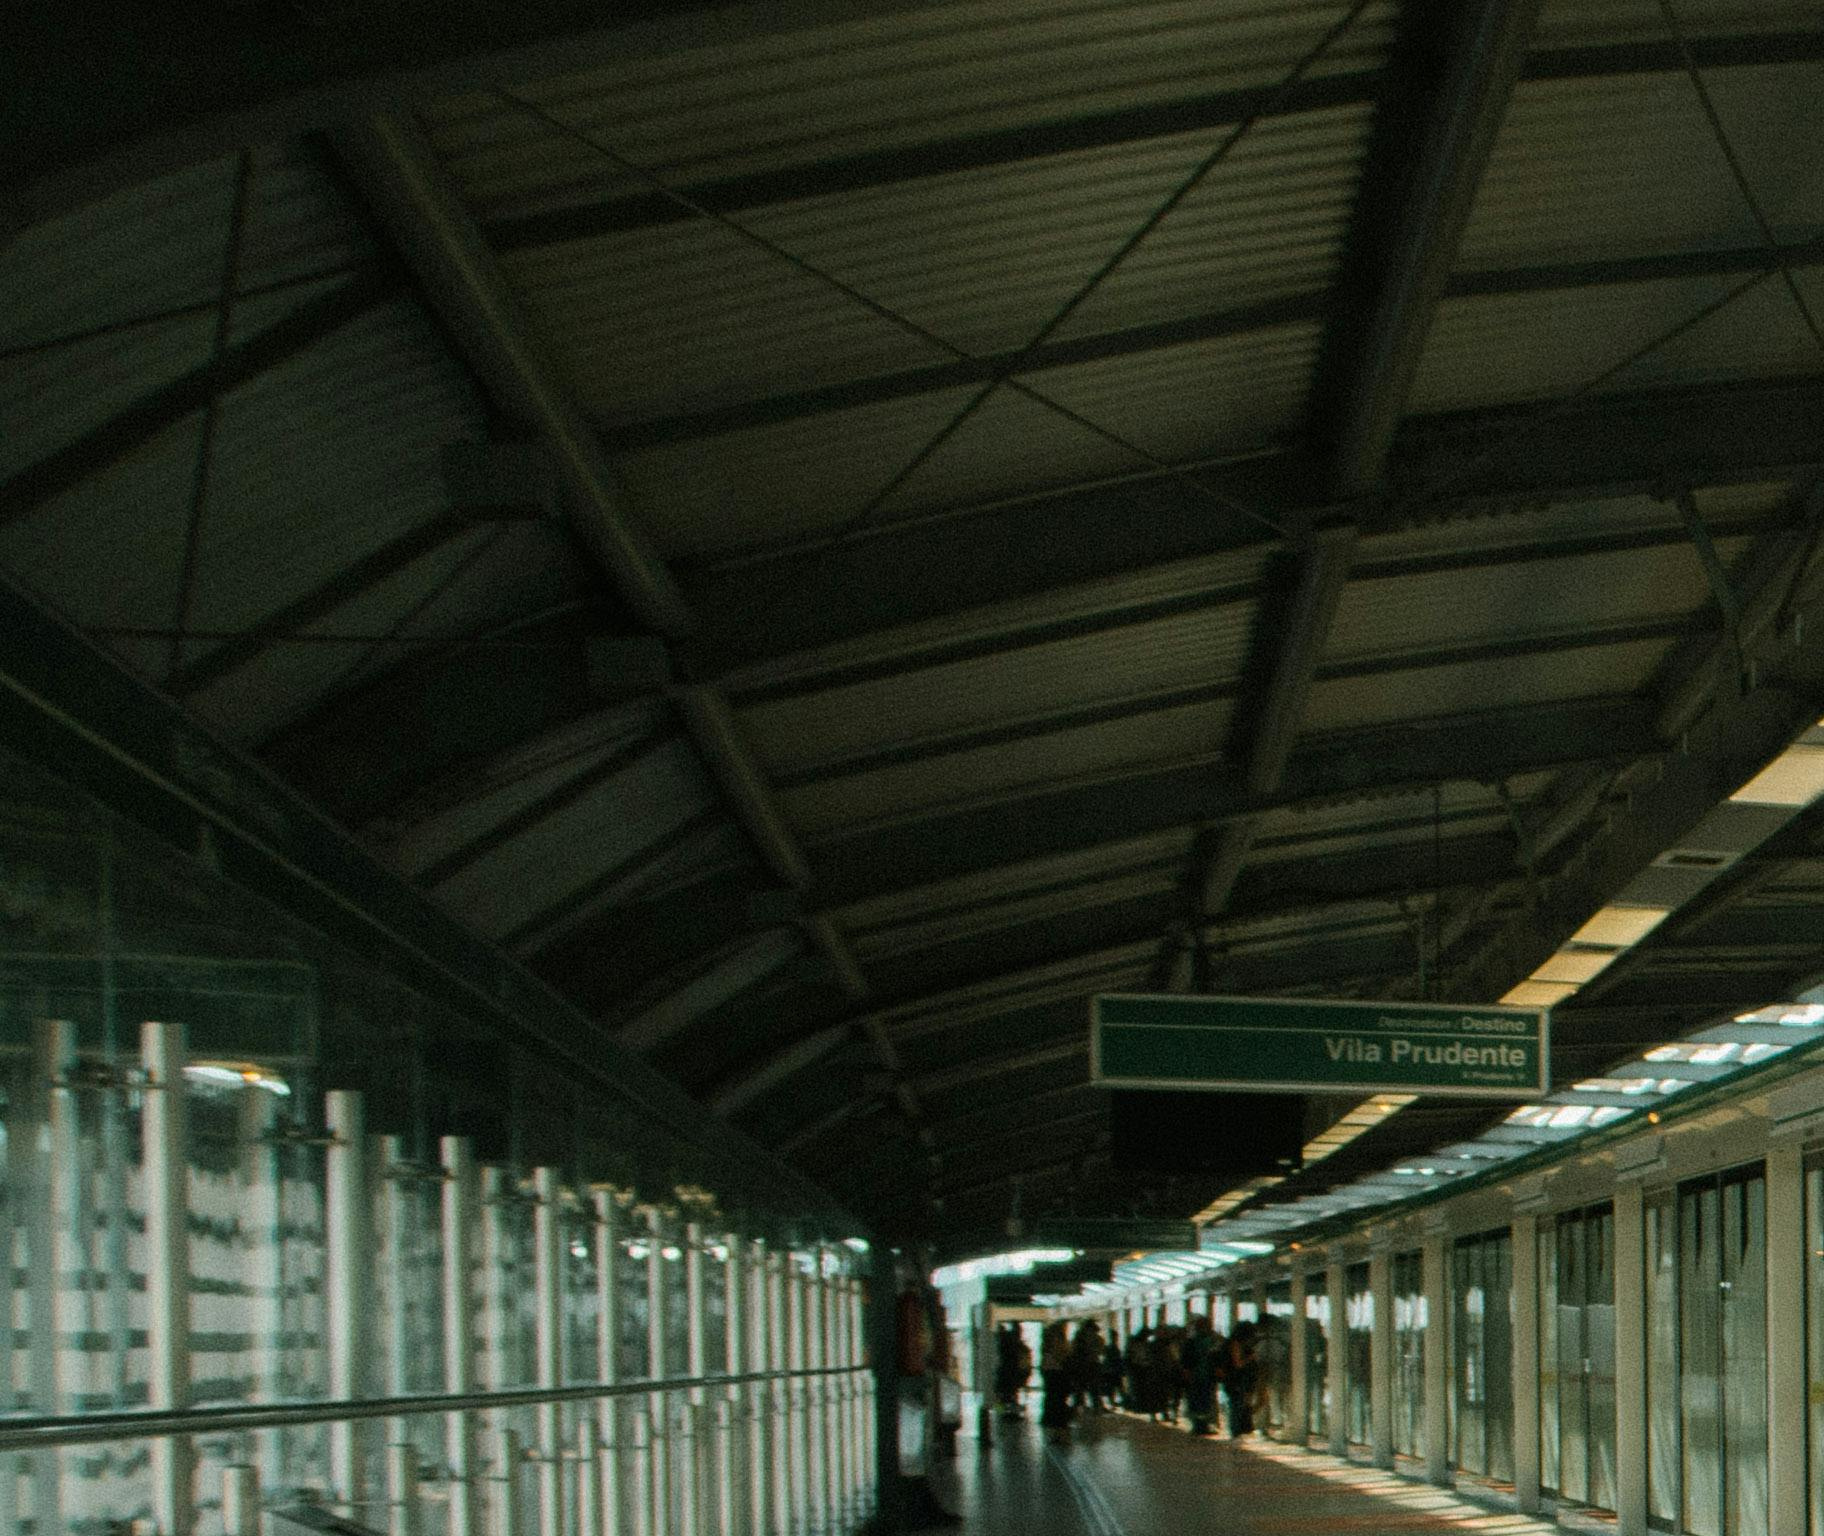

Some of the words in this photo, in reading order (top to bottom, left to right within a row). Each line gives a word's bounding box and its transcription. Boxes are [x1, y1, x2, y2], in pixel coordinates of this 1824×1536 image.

[1461, 1016, 1527, 1033] Destino
[1325, 1037, 1382, 1063] Vila
[1391, 1040, 1527, 1067] Prudente
